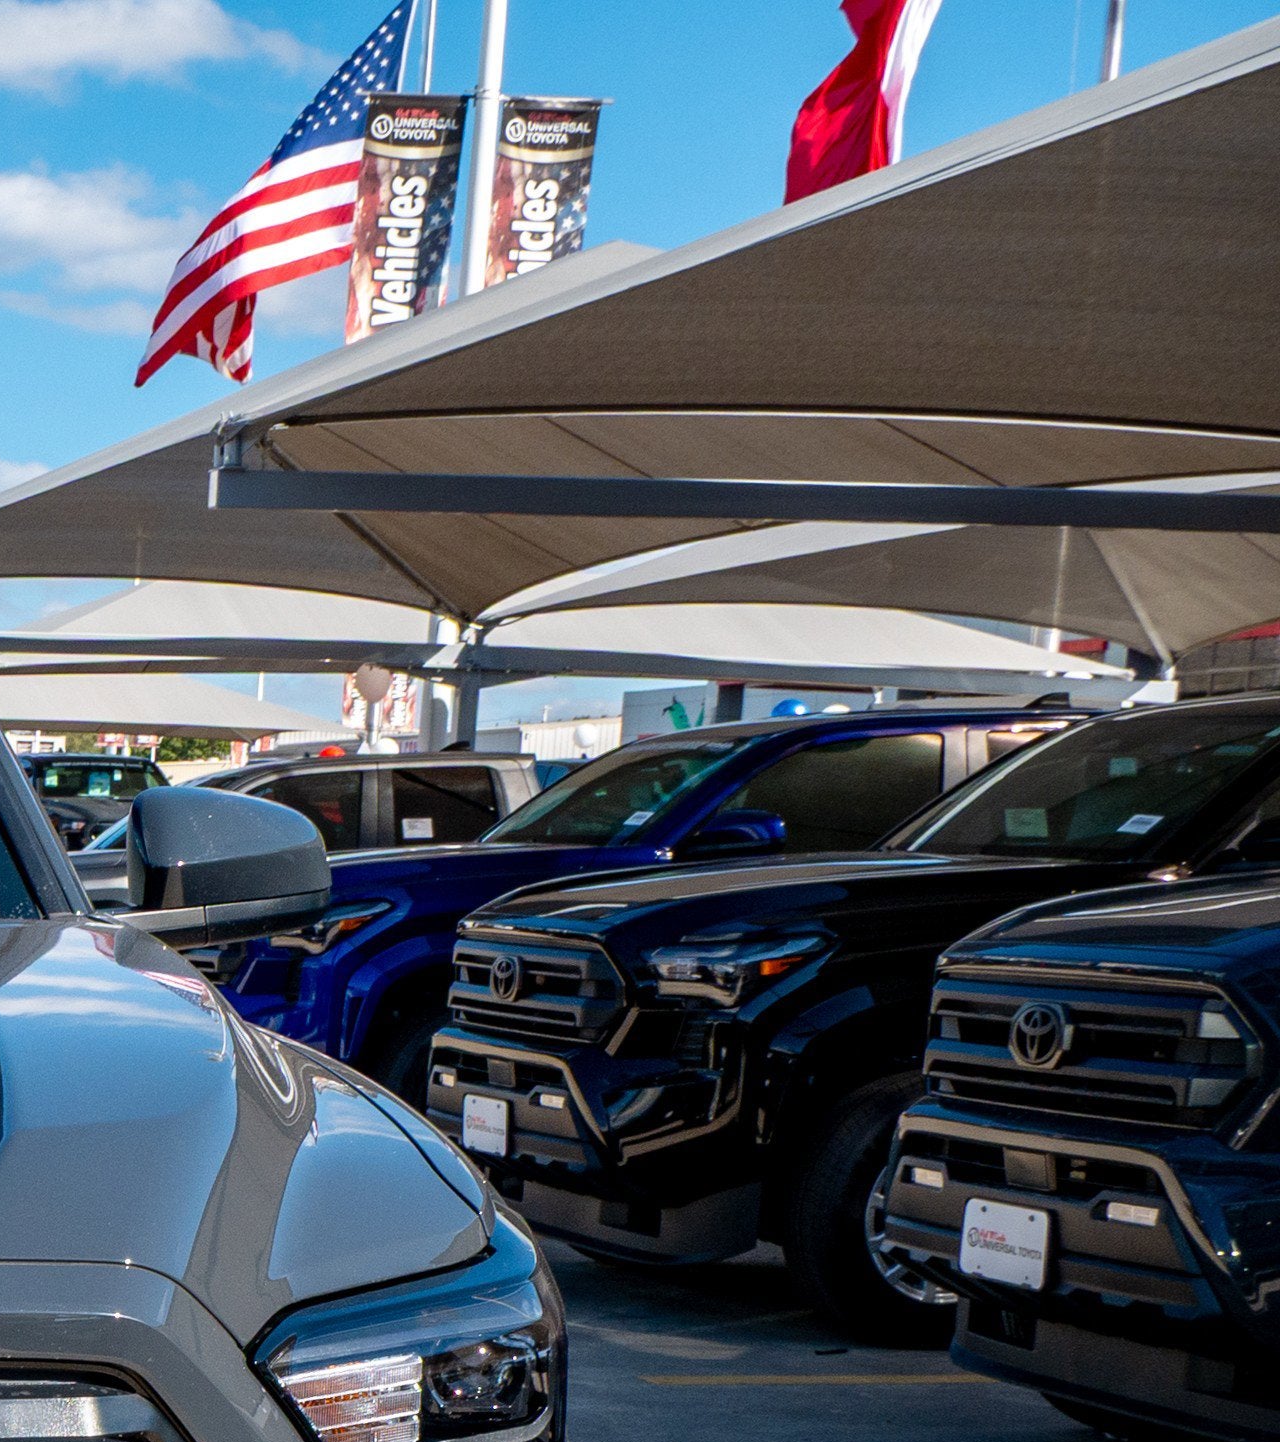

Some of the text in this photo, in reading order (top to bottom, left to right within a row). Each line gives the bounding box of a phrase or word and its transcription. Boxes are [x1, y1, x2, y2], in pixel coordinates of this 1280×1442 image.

[393, 117, 458, 130] UNIVERSAL
[526, 120, 592, 134] UNIVERSAL
[392, 129, 437, 140] TOYOTA
[525, 132, 569, 145] TOYOTA
[370, 175, 428, 327] Vehicles
